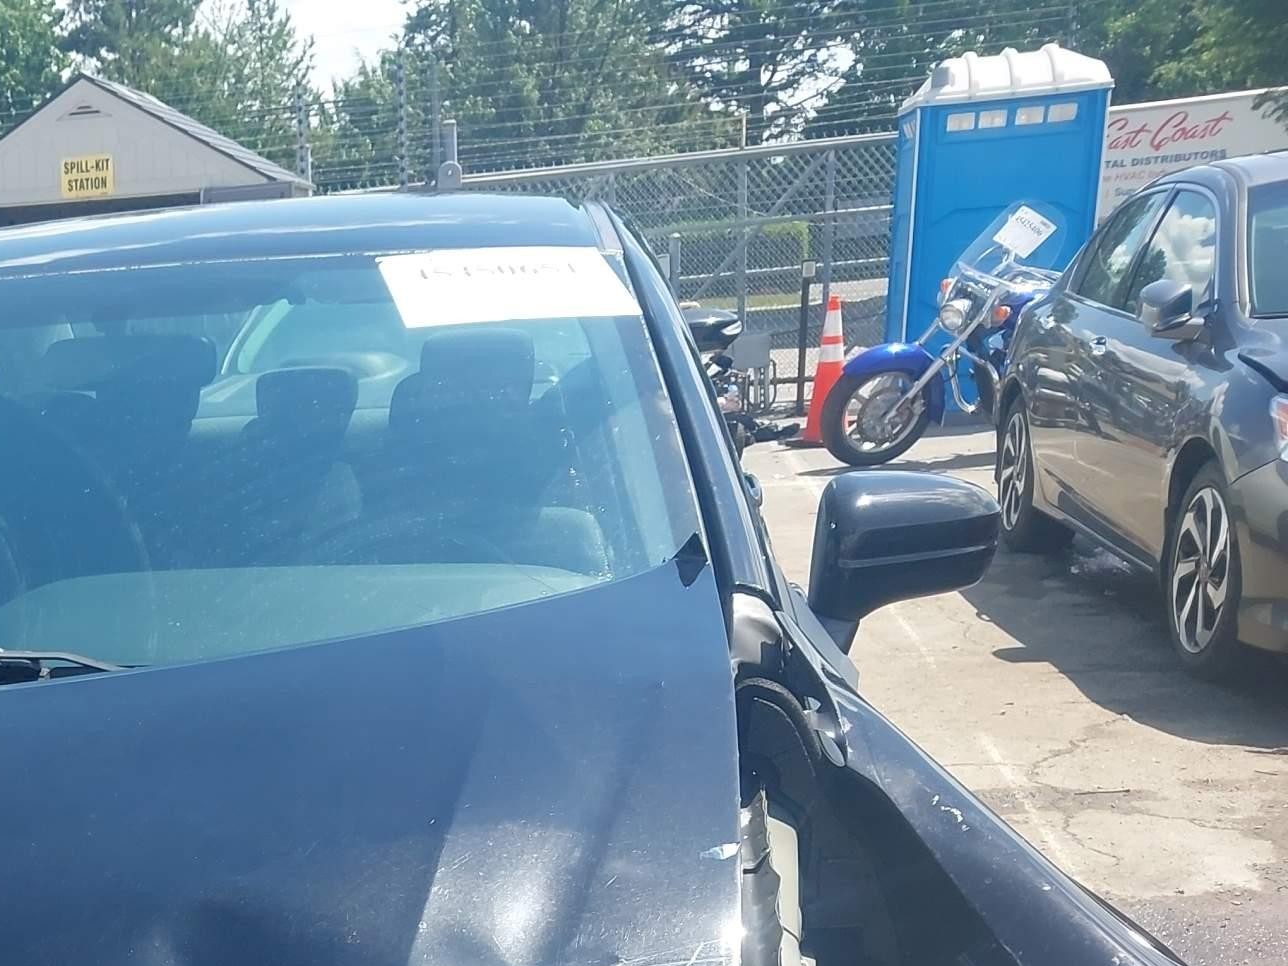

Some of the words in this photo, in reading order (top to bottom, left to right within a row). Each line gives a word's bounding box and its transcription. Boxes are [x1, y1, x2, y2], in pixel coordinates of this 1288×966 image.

[1150, 111, 1233, 152] Coast
[63, 158, 110, 175] SPILL-KIT
[1131, 149, 1227, 167] DISTRIBUTORS
[67, 175, 107, 192] STATION
